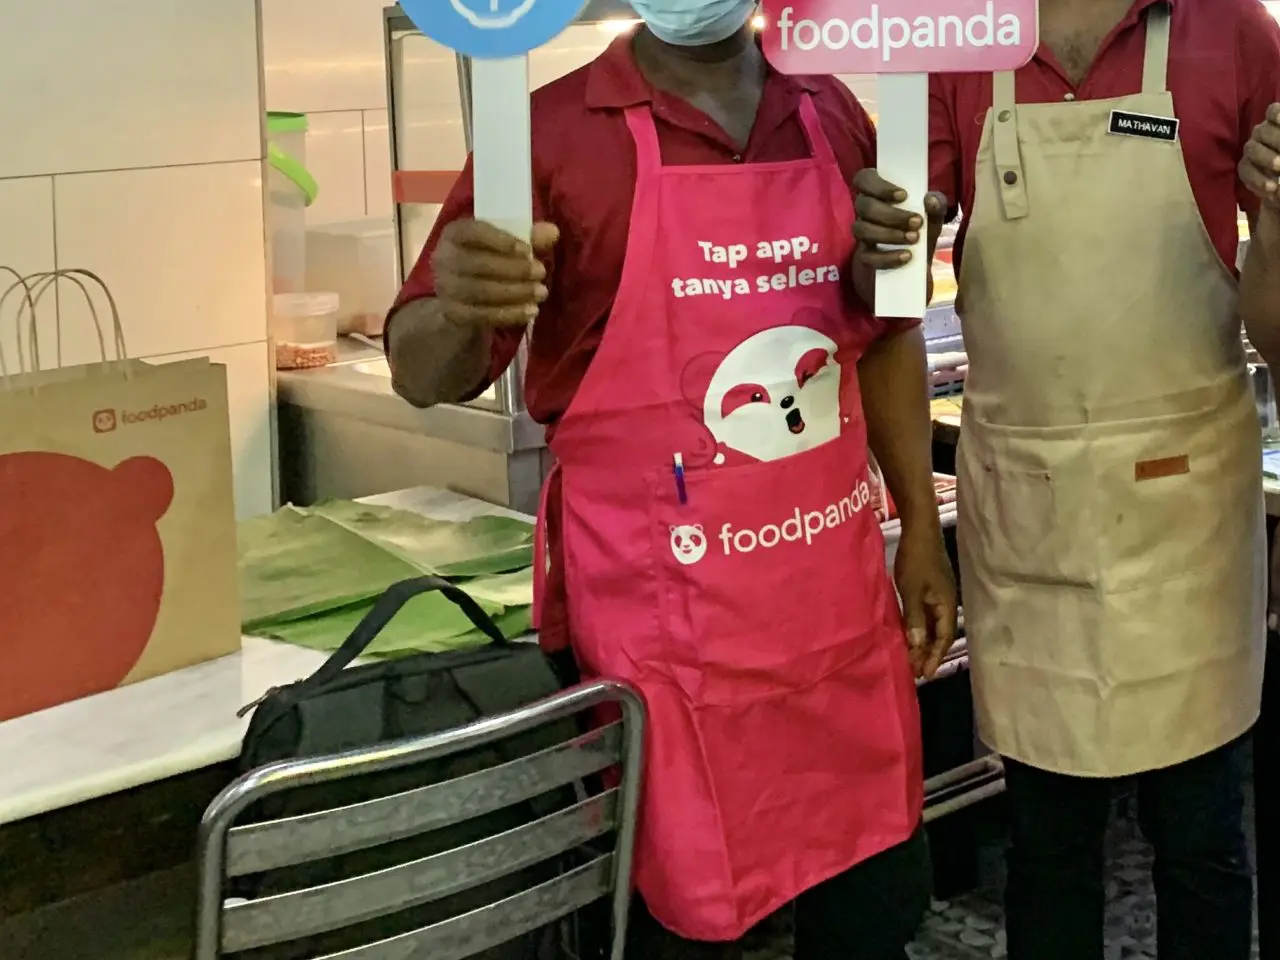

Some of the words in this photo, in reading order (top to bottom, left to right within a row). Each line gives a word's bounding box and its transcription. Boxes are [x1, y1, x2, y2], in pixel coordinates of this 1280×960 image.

[777, 1, 1021, 60] foodpanda
[1118, 118, 1170, 135] MATHAVAN
[698, 241, 747, 268] Tap
[757, 235, 818, 263] app,
[671, 276, 750, 300] tanya
[756, 264, 840, 294] selera
[122, 397, 207, 425] foodpanda
[719, 479, 870, 555] foodpanda
